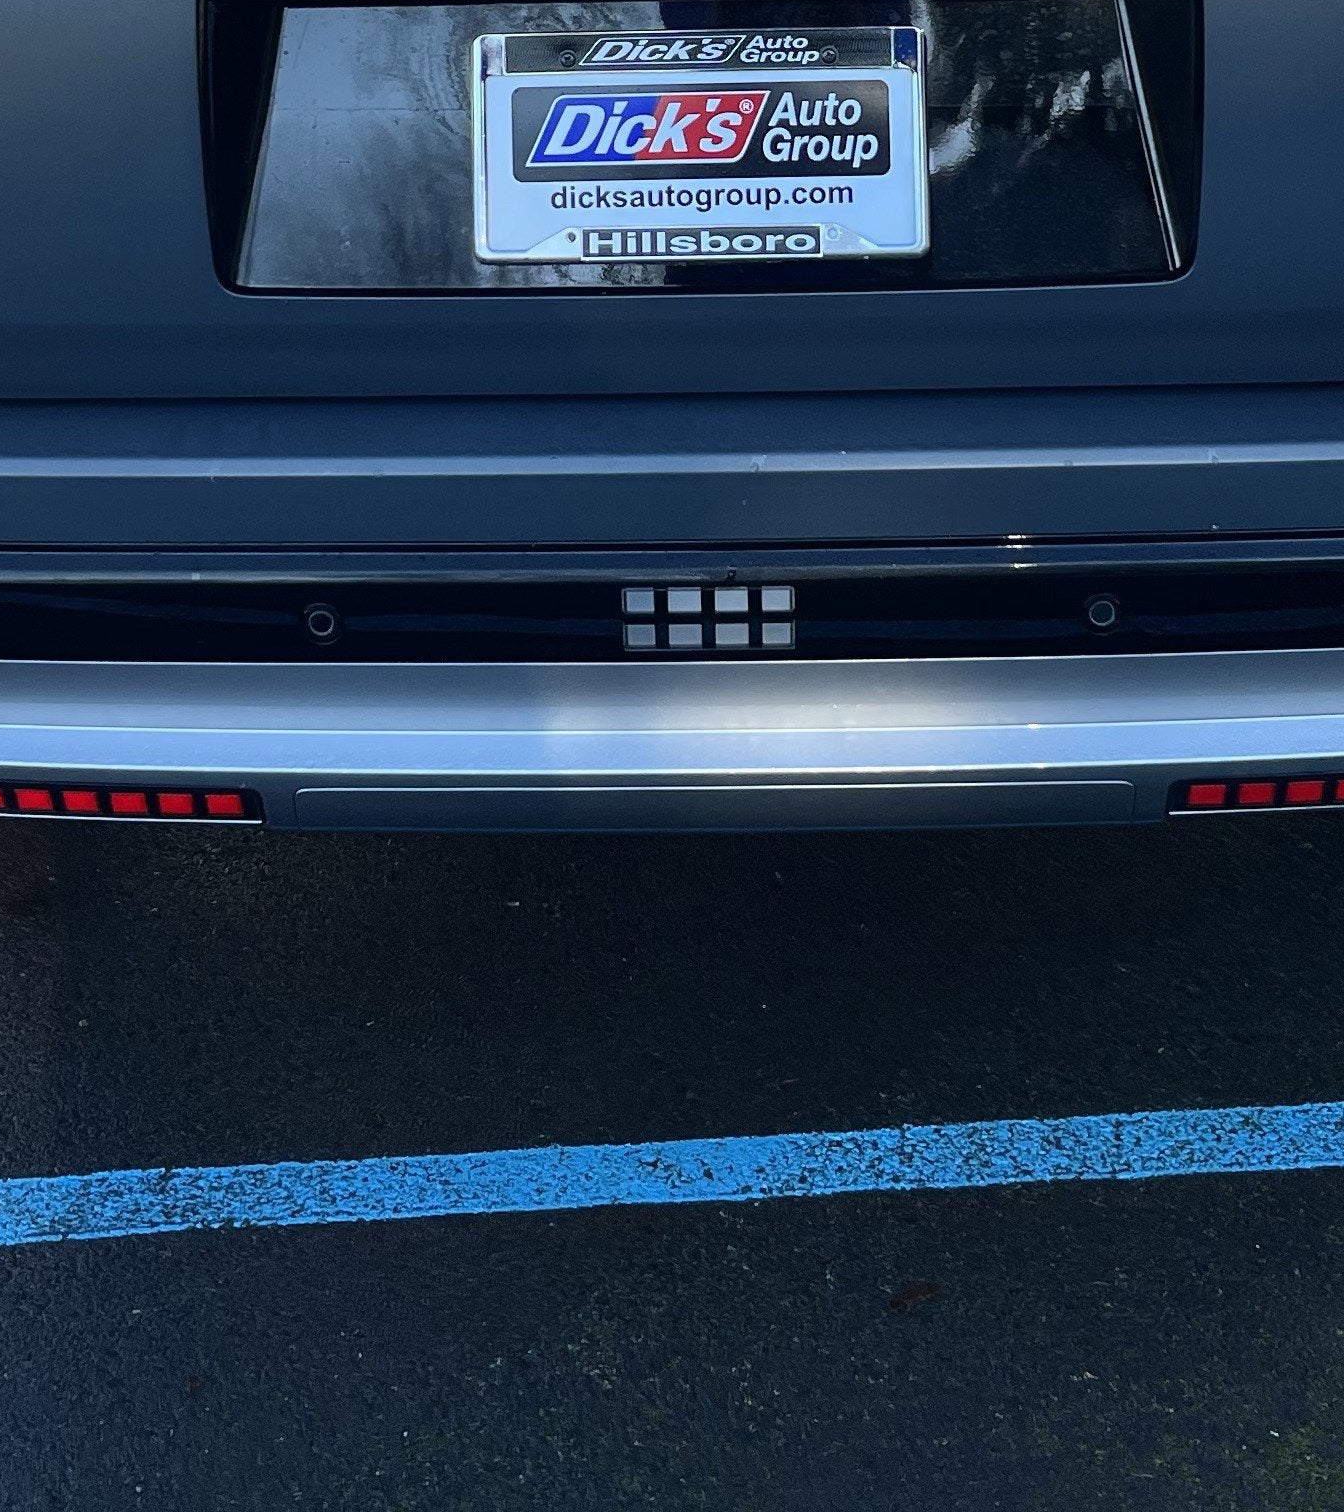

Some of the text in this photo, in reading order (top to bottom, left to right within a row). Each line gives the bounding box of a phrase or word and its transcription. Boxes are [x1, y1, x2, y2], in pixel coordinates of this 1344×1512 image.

[746, 35, 809, 49] Auto
[739, 47, 820, 64] Group
[768, 91, 862, 127] Auto
[762, 127, 878, 169] Group
[550, 184, 854, 212] dicksautogroup.com
[588, 230, 816, 254] Hillsboro
